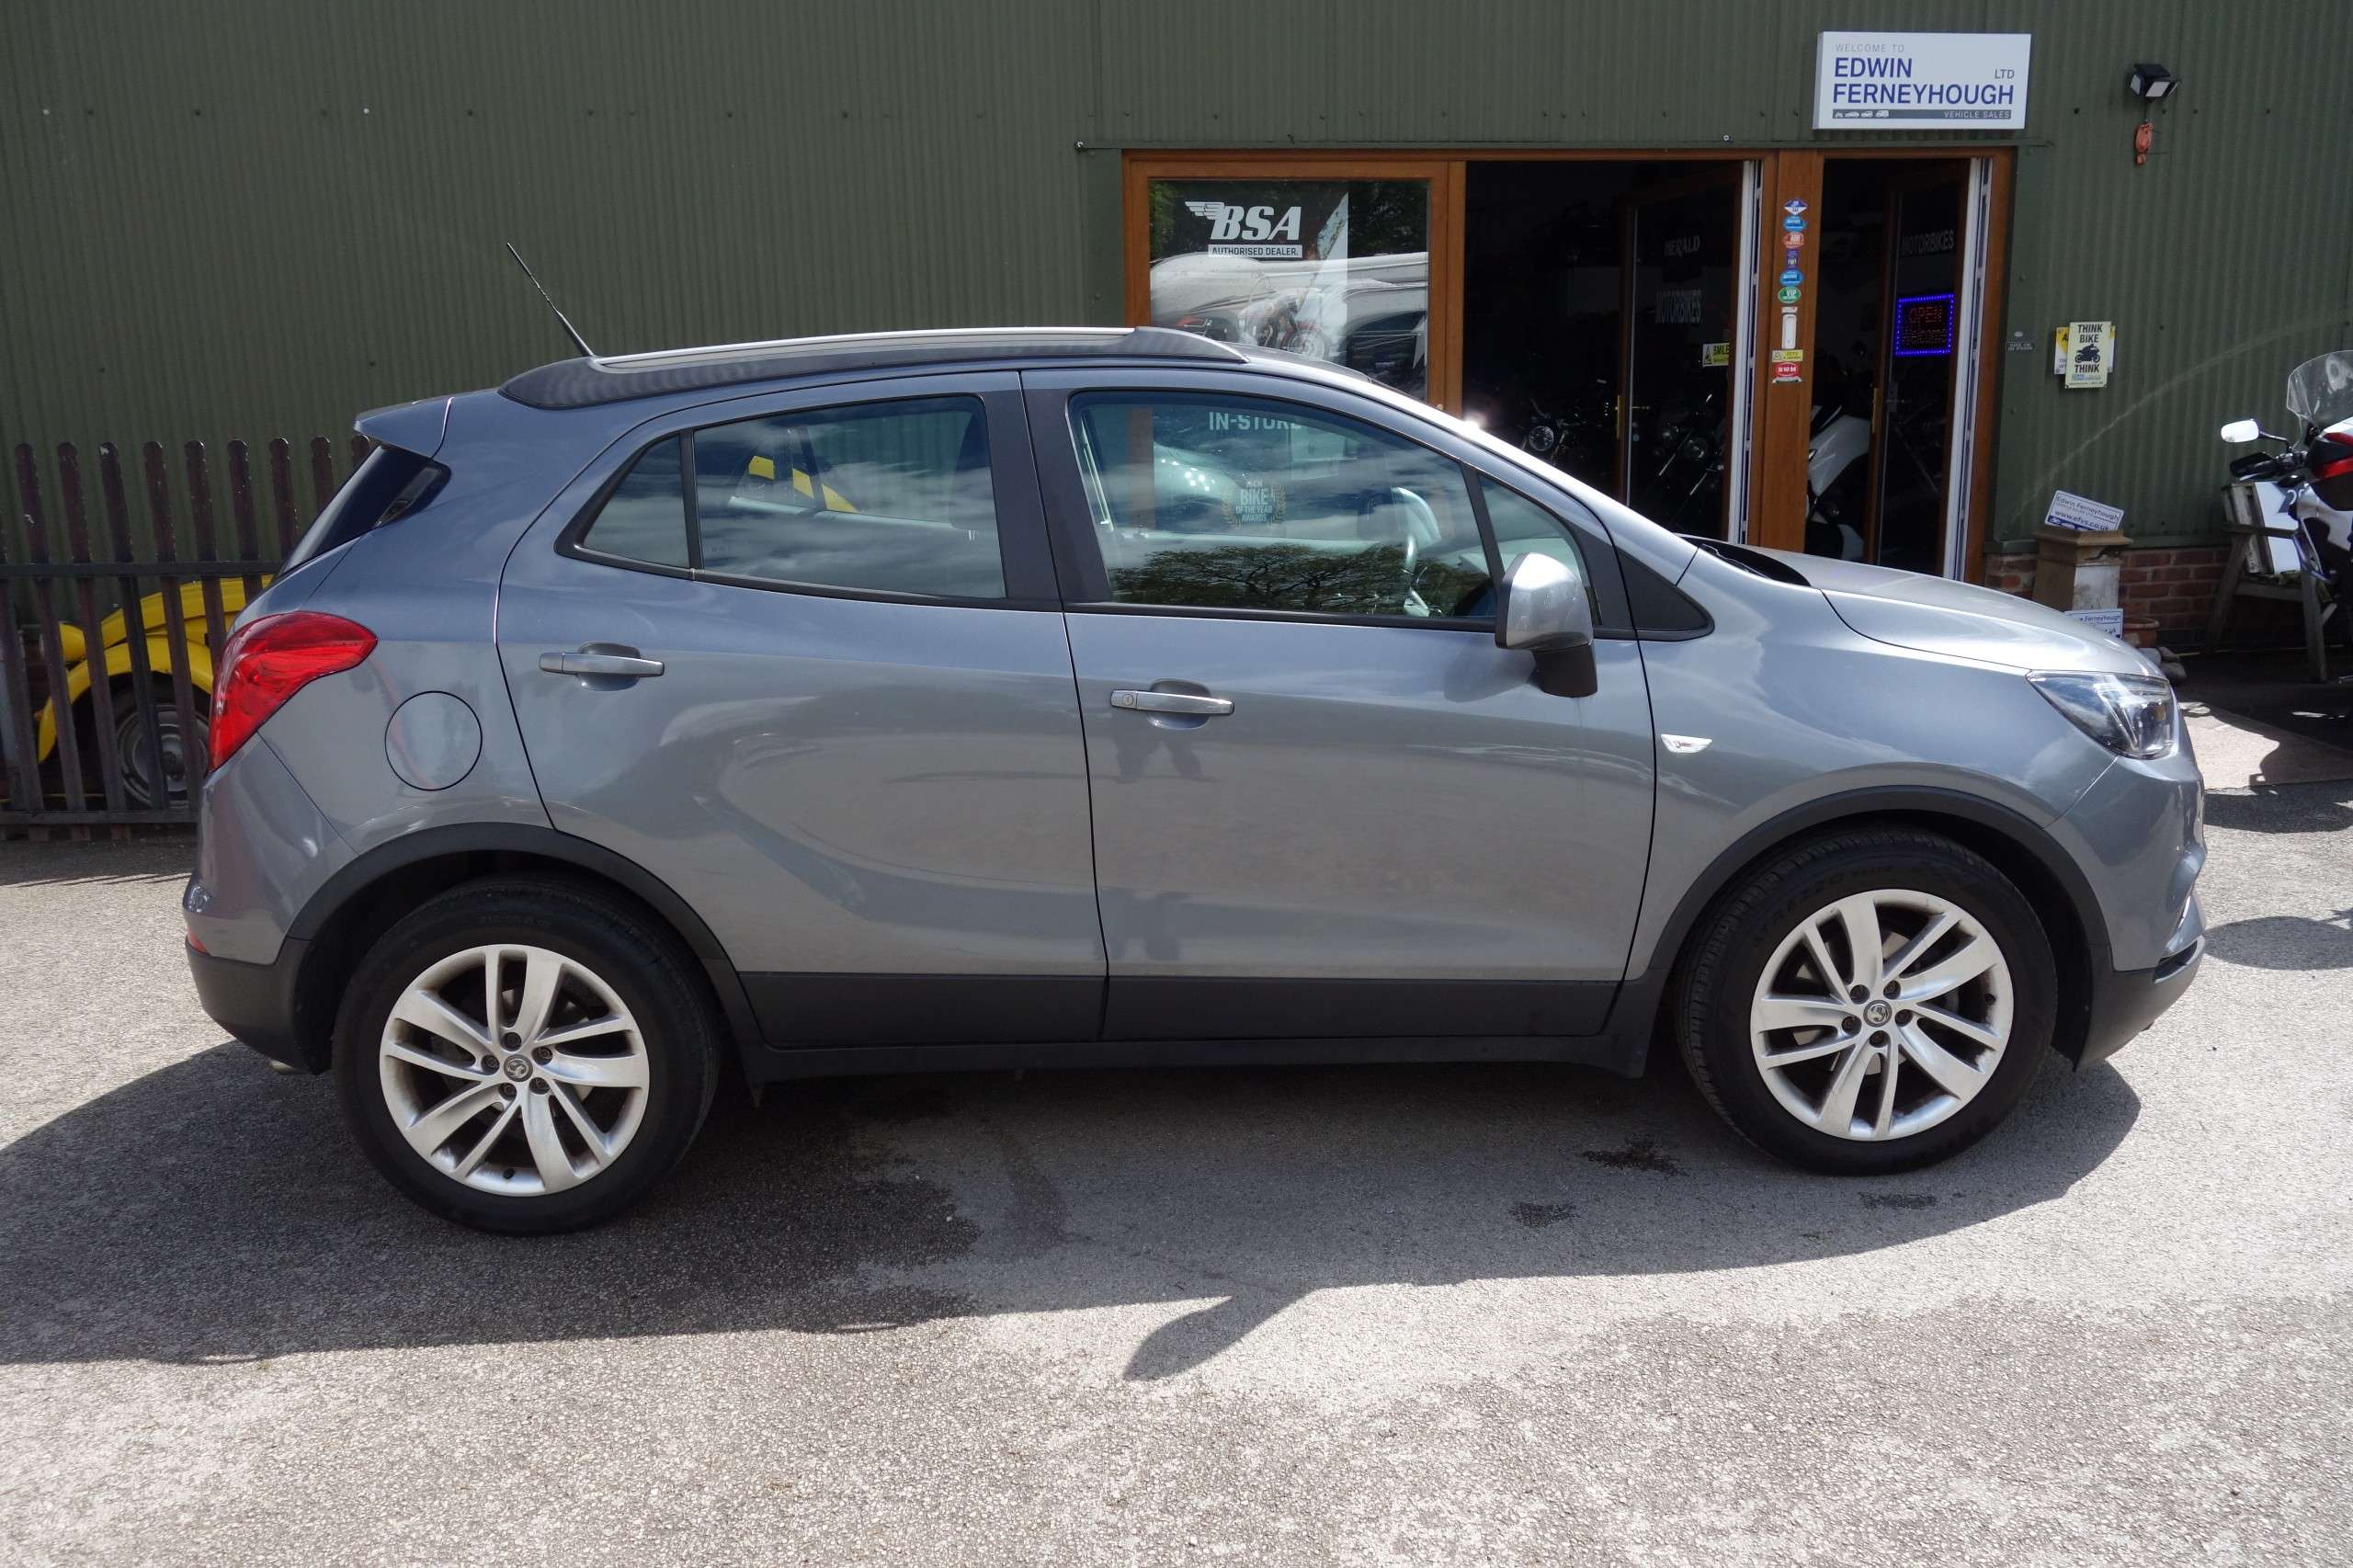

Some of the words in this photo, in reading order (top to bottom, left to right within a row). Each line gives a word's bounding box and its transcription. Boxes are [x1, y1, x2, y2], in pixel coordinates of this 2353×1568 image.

[1836, 43, 1887, 52] WELCOME
[1892, 44, 1904, 52] TO
[1834, 57, 1913, 78] EDWIN
[1994, 69, 2015, 79] LTD
[1833, 83, 2014, 104] FERNEYHOUGH
[1944, 110, 1980, 119] VEHICLE
[1983, 110, 2009, 119] SALES
[1210, 205, 1302, 241] BSA
[1212, 246, 1264, 256] AUTHORISED
[2077, 324, 2103, 334] THINK
[2079, 334, 2099, 343] BIKE
[2075, 364, 2100, 373] THINK
[1240, 488, 1269, 506] BIKE
[2056, 496, 2075, 506] Edwin
[1256, 505, 1273, 514] YEAR
